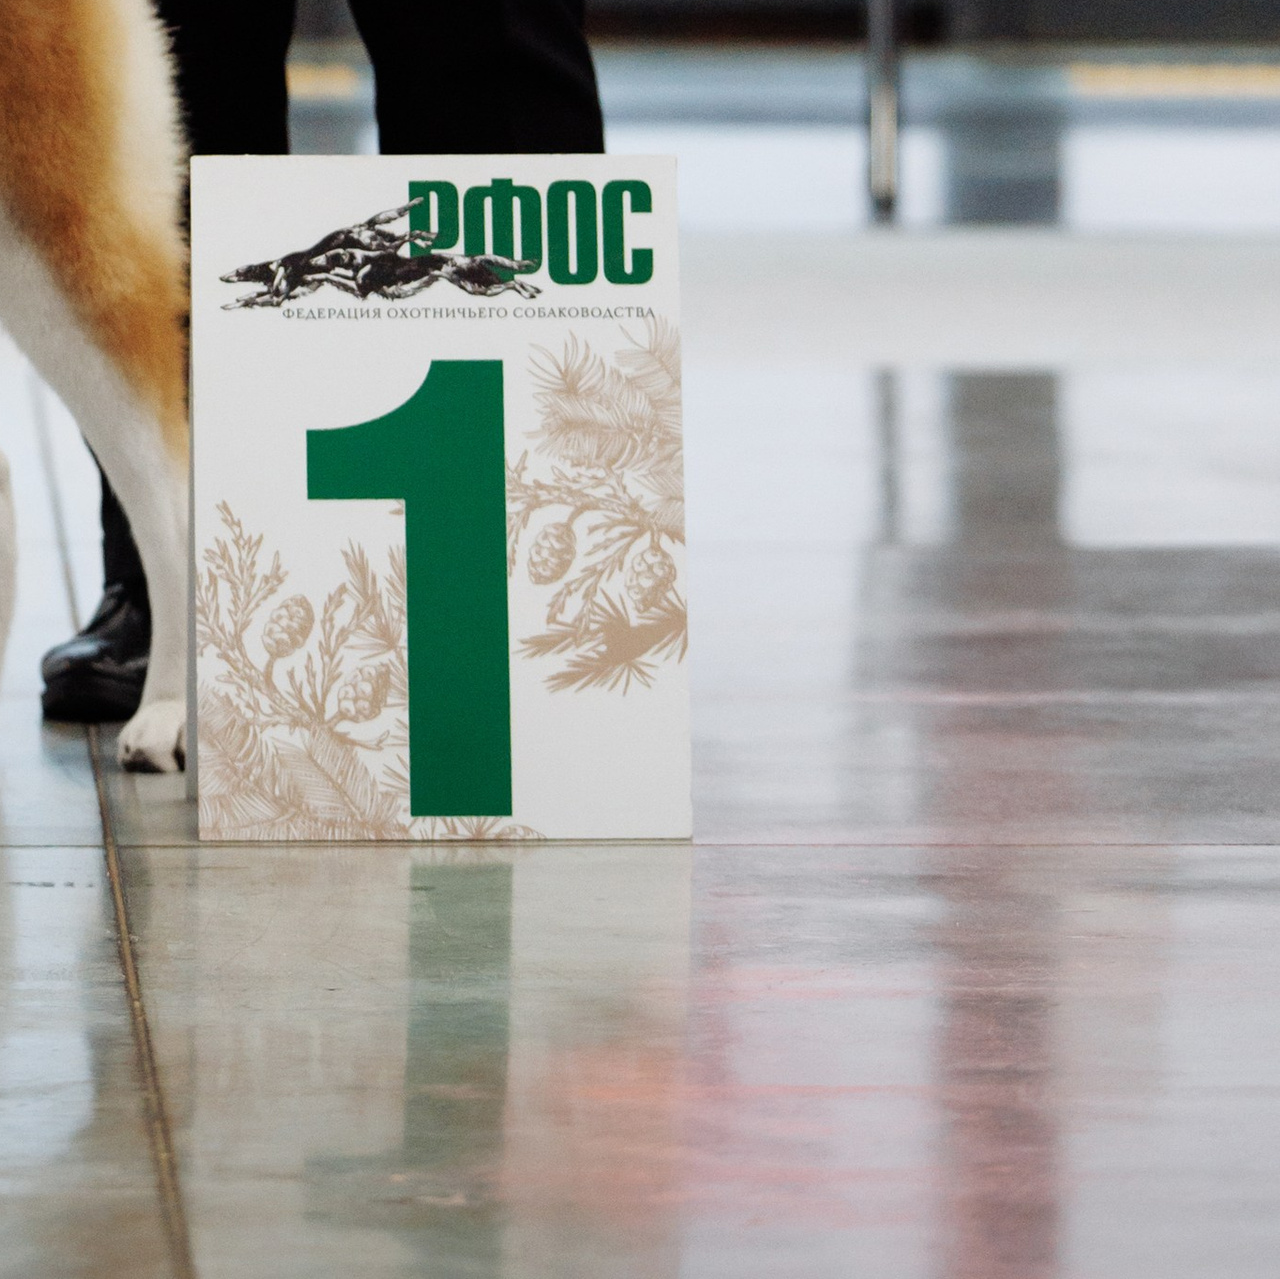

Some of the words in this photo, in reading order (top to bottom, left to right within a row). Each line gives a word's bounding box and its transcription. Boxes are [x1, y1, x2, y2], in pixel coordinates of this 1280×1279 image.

[408, 178, 653, 285] РФОС
[282, 306, 382, 321] ФЕДЕРАЦИЯ
[387, 306, 508, 319] ОХОТНИЧЬЕГО
[513, 305, 656, 320] СОБАКОВОДСТВА
[306, 359, 511, 816] 1
